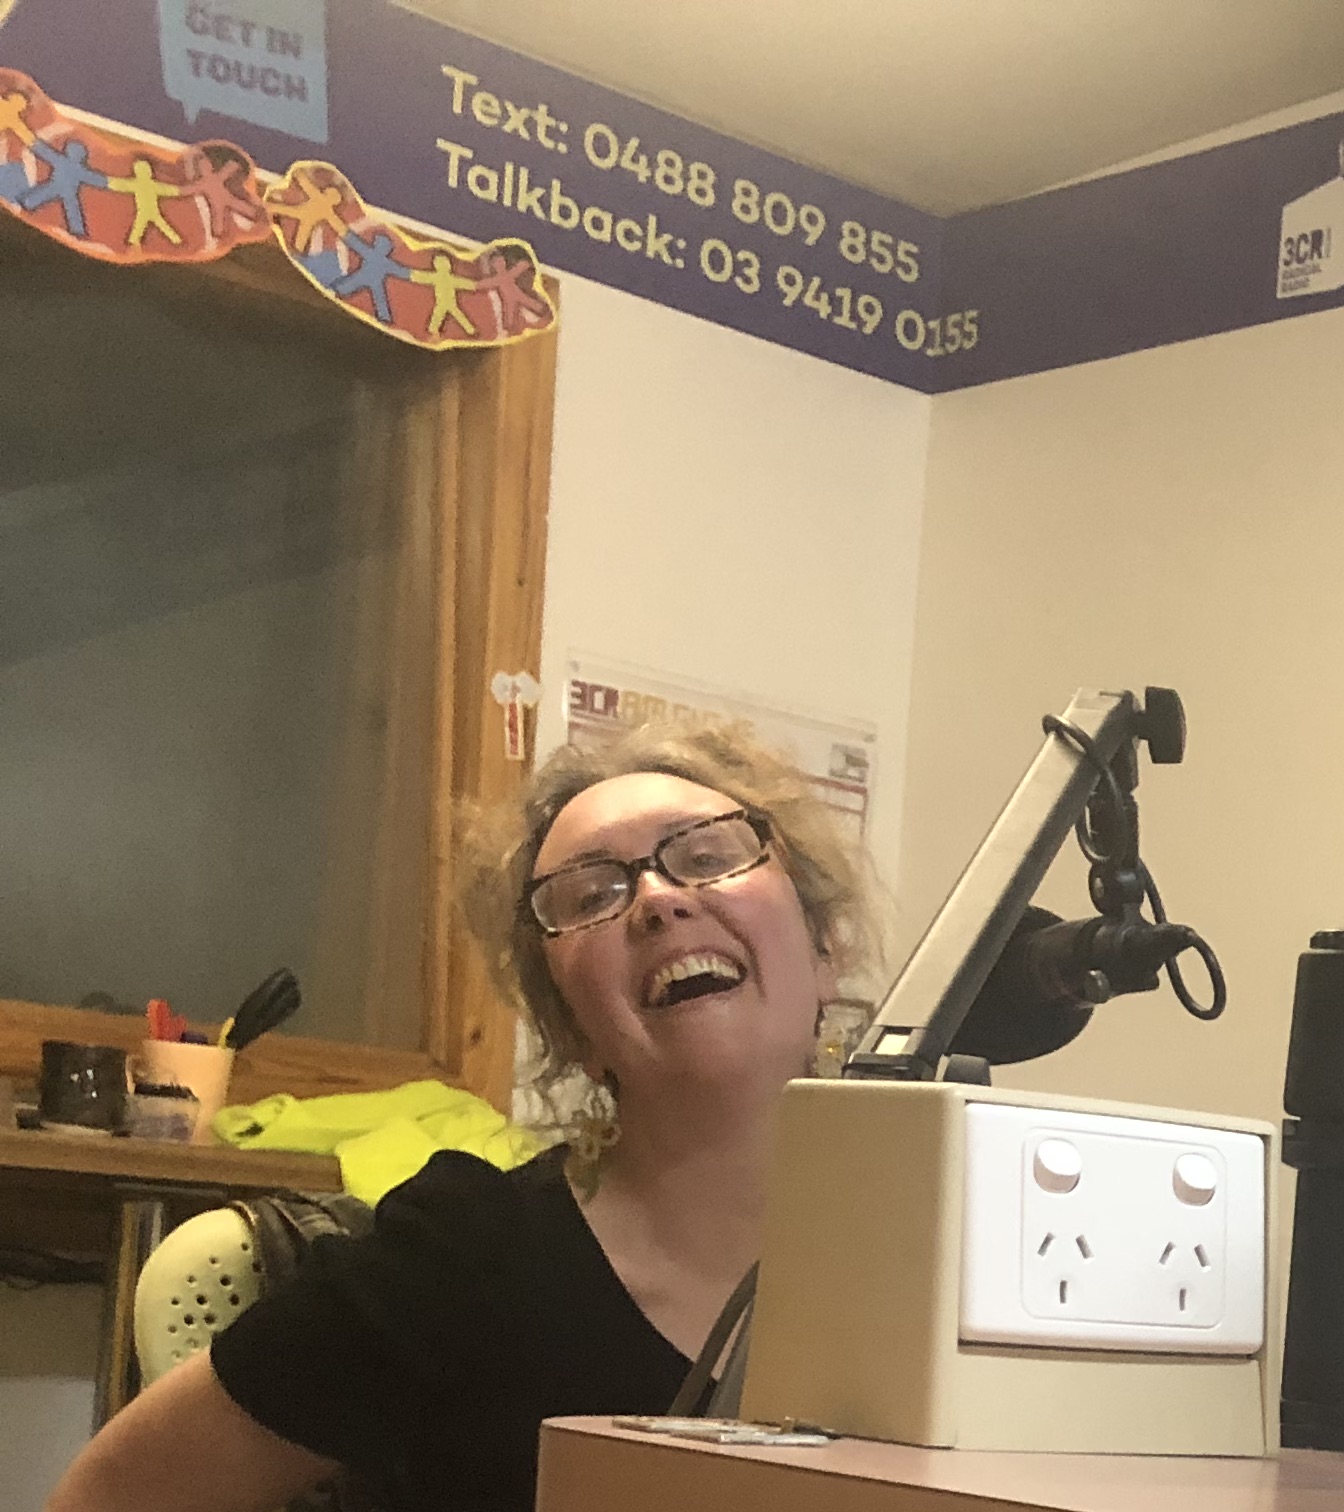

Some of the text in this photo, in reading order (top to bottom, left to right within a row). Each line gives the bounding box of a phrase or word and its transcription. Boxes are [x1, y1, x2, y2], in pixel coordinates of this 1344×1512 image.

[185, 0, 303, 59] GET IN
[186, 48, 308, 103] TOUCH
[441, 64, 920, 283] Text: 0488 809 855
[435, 137, 980, 357] Talkback: 03 9419 0155
[1283, 229, 1324, 267] 3CR
